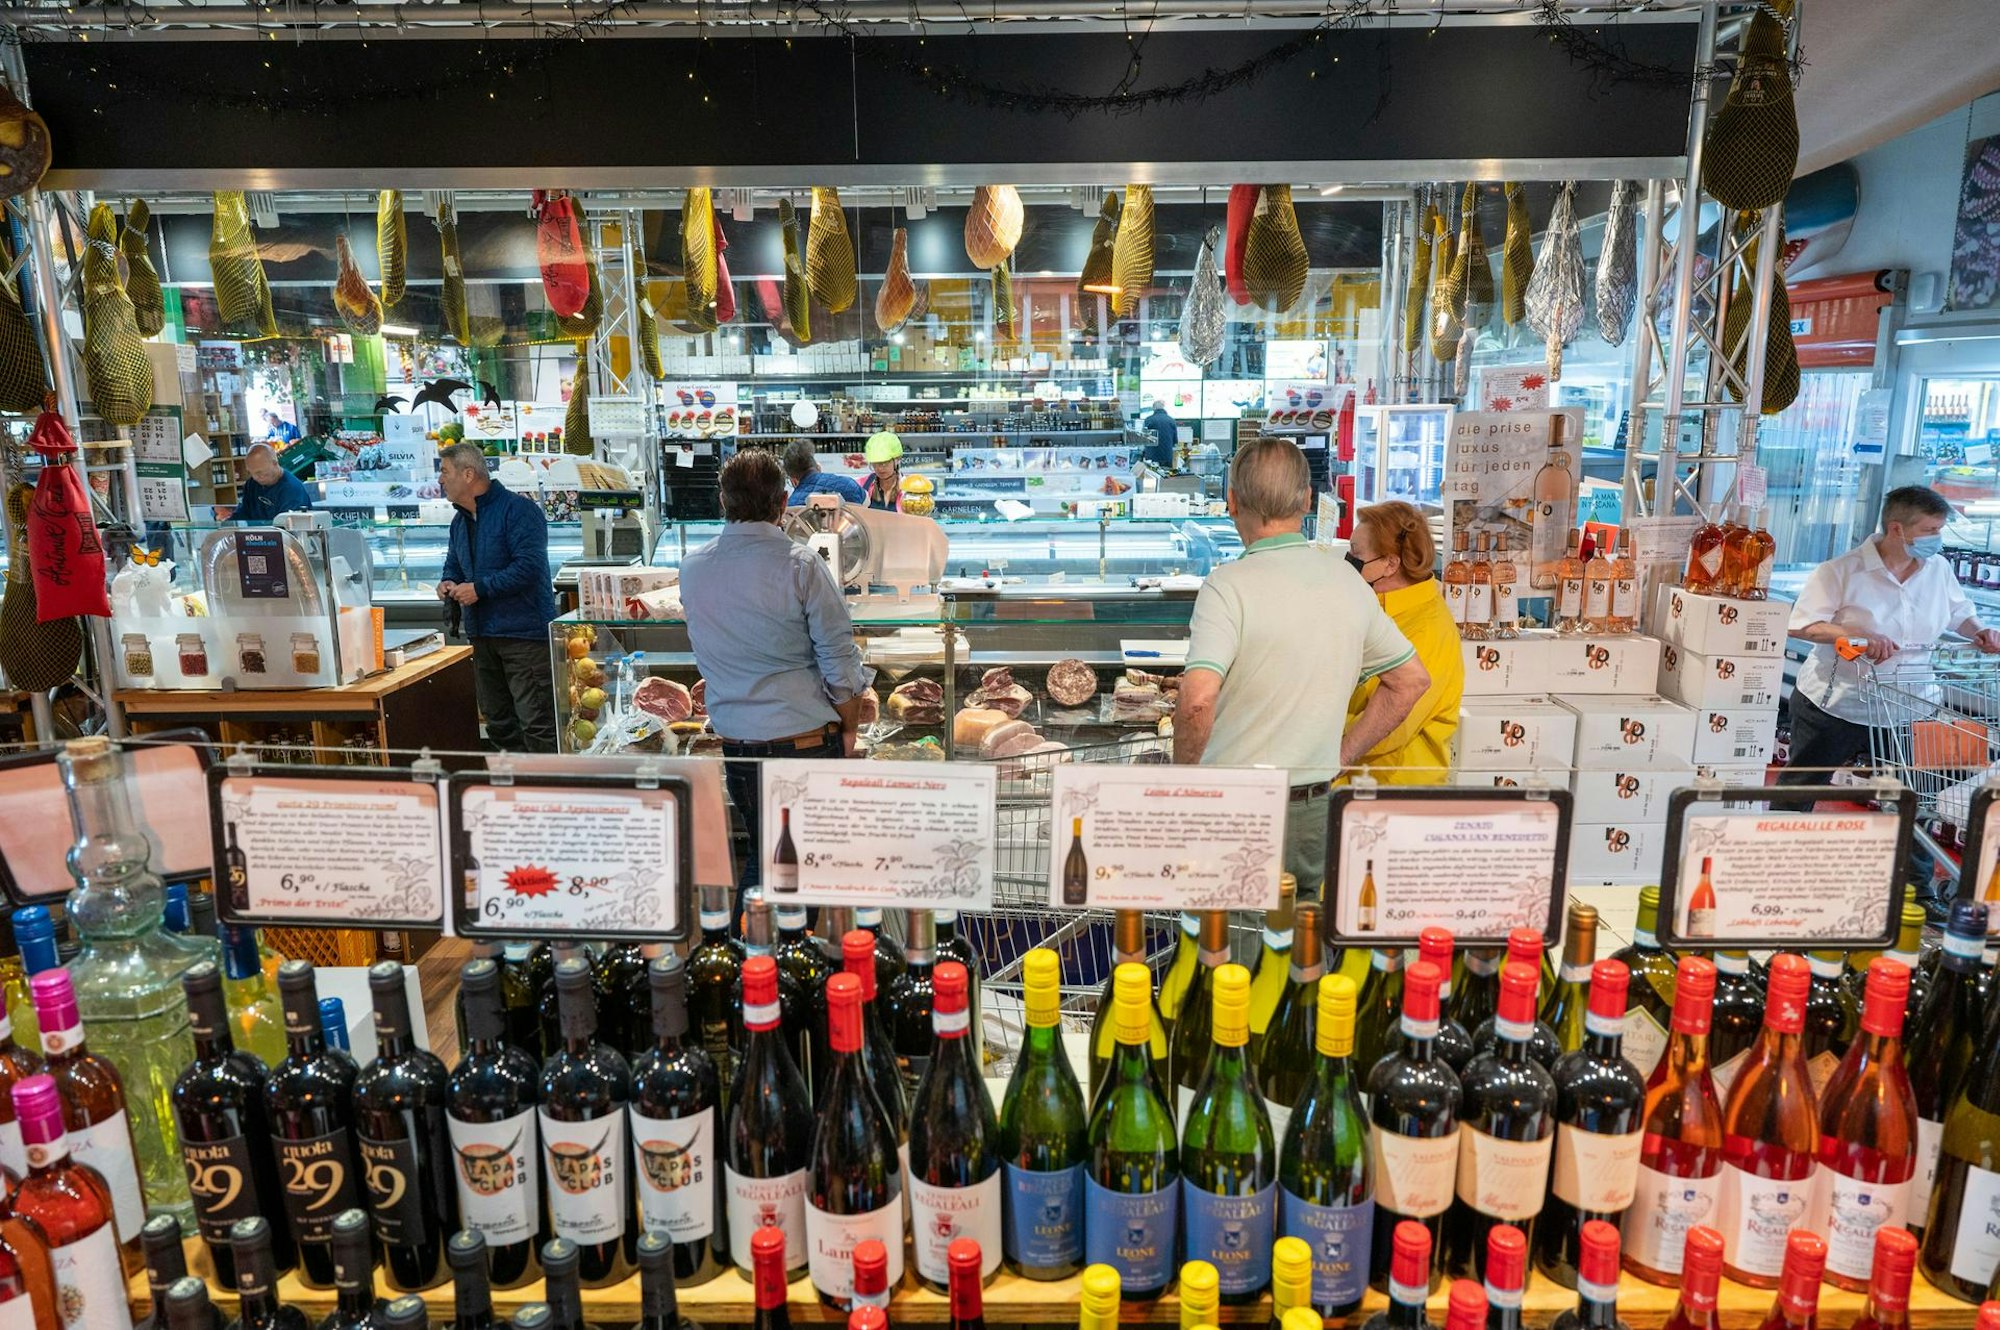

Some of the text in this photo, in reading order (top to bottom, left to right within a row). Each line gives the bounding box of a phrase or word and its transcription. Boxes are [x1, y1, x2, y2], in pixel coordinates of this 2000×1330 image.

[1457, 422, 1532, 440] die prise
[1455, 442, 1500, 453] luxus
[1454, 460, 1532, 475] für jeden
[1453, 482, 1480, 494] tag
[941, 505, 981, 514] GARNELEN
[1588, 501, 1617, 510] TSCANA
[1756, 820, 1866, 832] REGALEALI LE ROSE
[804, 852, 832, 868] 8,40
[874, 856, 902, 872] 7,90
[1095, 864, 1124, 880] 9,90
[280, 873, 315, 893] 6,90
[294, 898, 311, 908] der
[484, 896, 525, 920] 6,90
[283, 1140, 333, 1158] quota
[470, 1156, 525, 1177] TAPAS
[557, 1156, 612, 1176] TAPAS
[648, 1154, 702, 1174] TAPAS
[185, 1158, 243, 1213] 29
[283, 1156, 344, 1211] 29
[480, 1172, 527, 1191] CLUB
[567, 1172, 614, 1190] CLUB
[657, 1171, 703, 1189] CLUB
[818, 1238, 853, 1260] Lam
[1116, 1247, 1156, 1258] LEONE
[1212, 1250, 1250, 1261] LEONE
